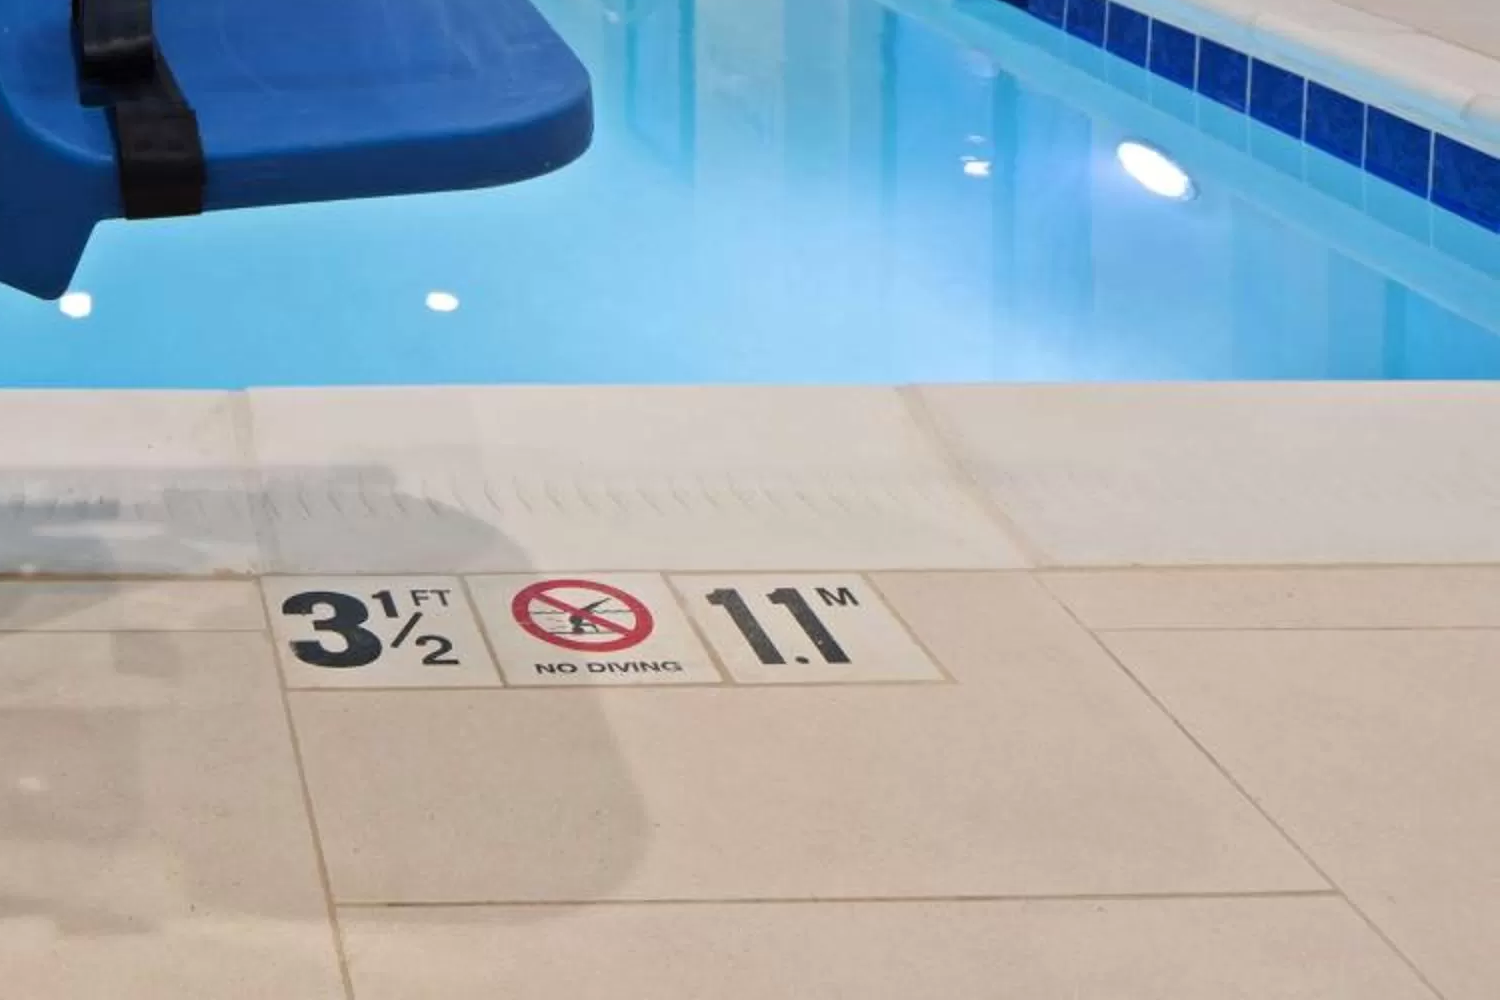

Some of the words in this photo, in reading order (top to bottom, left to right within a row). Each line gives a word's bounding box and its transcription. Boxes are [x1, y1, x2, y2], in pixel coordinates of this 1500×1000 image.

[409, 589, 451, 606] FT
[705, 588, 852, 664] 1.1
[534, 662, 577, 674] NO
[587, 660, 682, 674] DIVING
